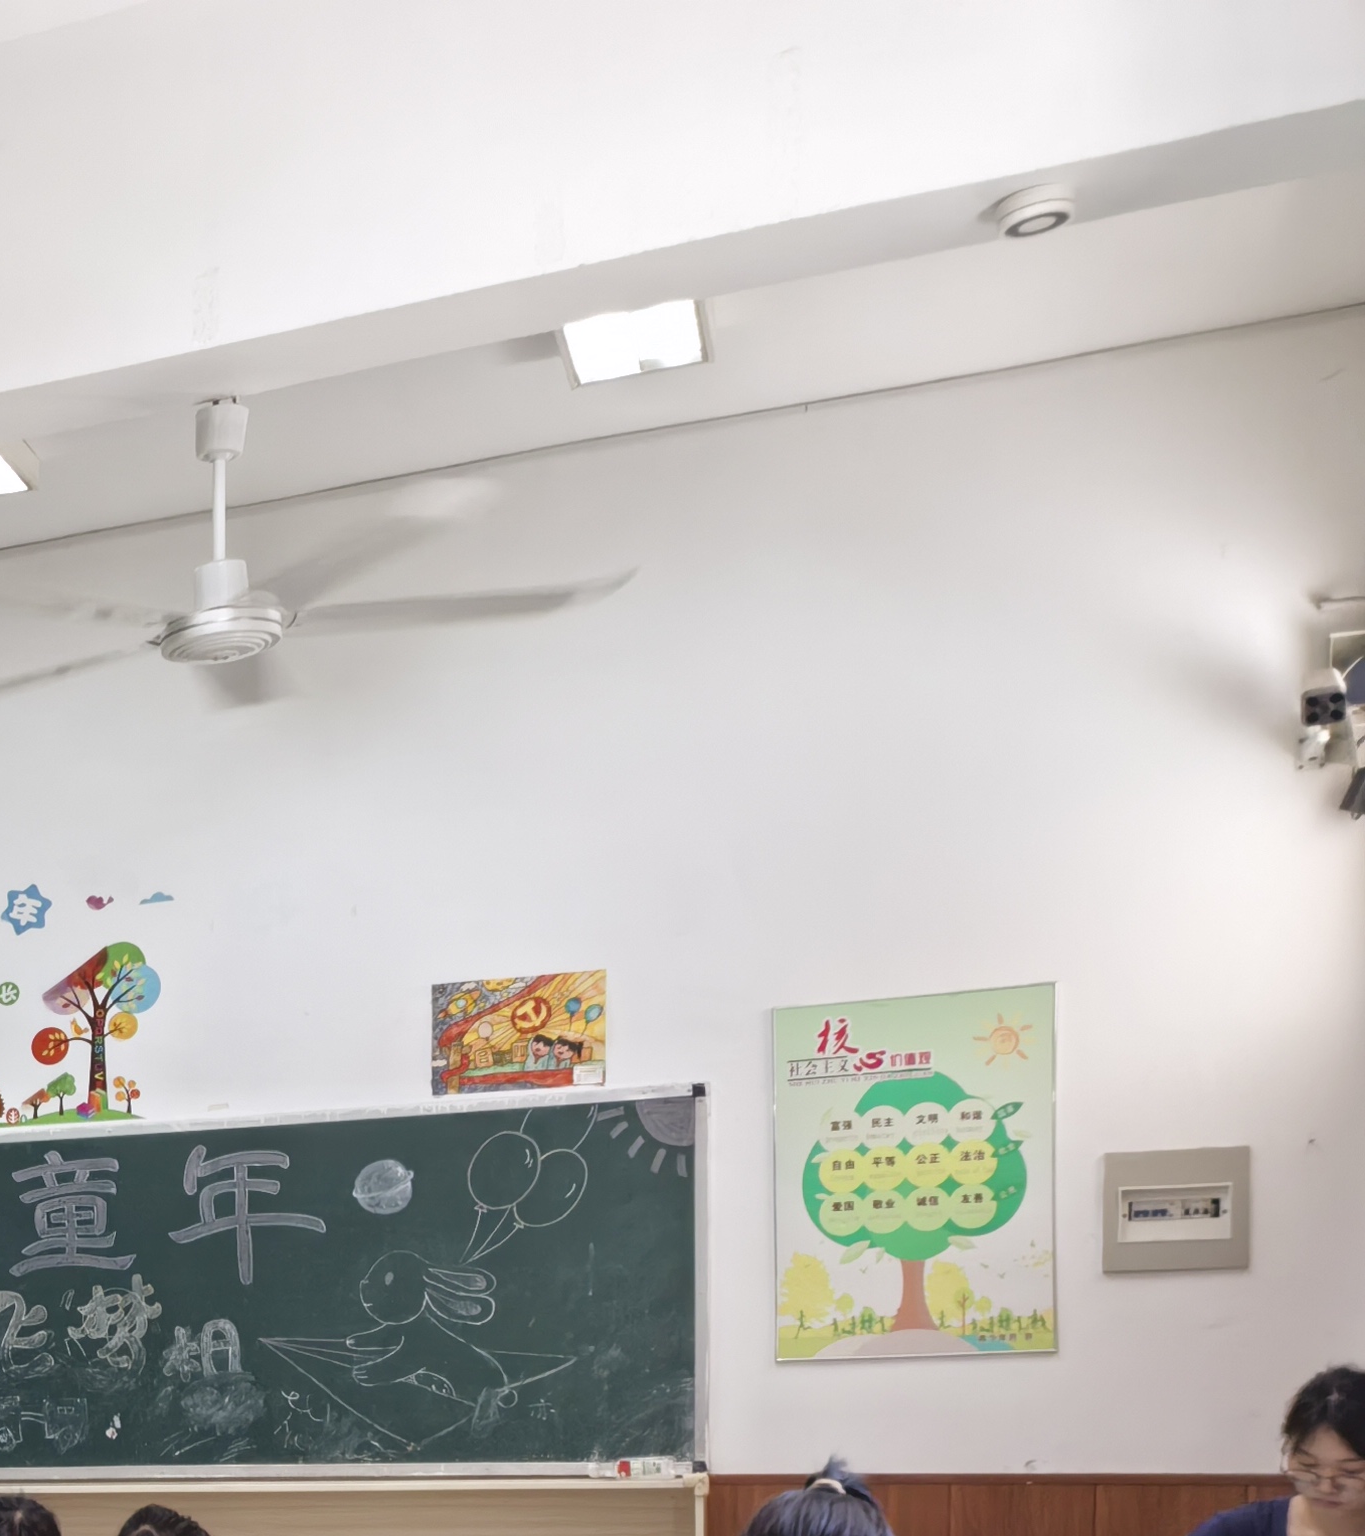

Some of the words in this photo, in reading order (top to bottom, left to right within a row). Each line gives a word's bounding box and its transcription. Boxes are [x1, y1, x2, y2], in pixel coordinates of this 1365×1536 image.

[789, 1059, 849, 1077] 社会主义
[830, 1120, 853, 1131] 富强
[871, 1117, 894, 1128] 民主
[915, 1113, 939, 1125] 文明
[960, 1110, 983, 1121] 和谐
[832, 1159, 855, 1171] 自由
[871, 1156, 896, 1167] 平等
[915, 1153, 940, 1165] 公正
[959, 1150, 985, 1162] 法治
[831, 1201, 854, 1212] 爱国
[872, 1199, 896, 1209] 敬业
[916, 1196, 939, 1206] 诚信
[960, 1193, 984, 1203] 友善
